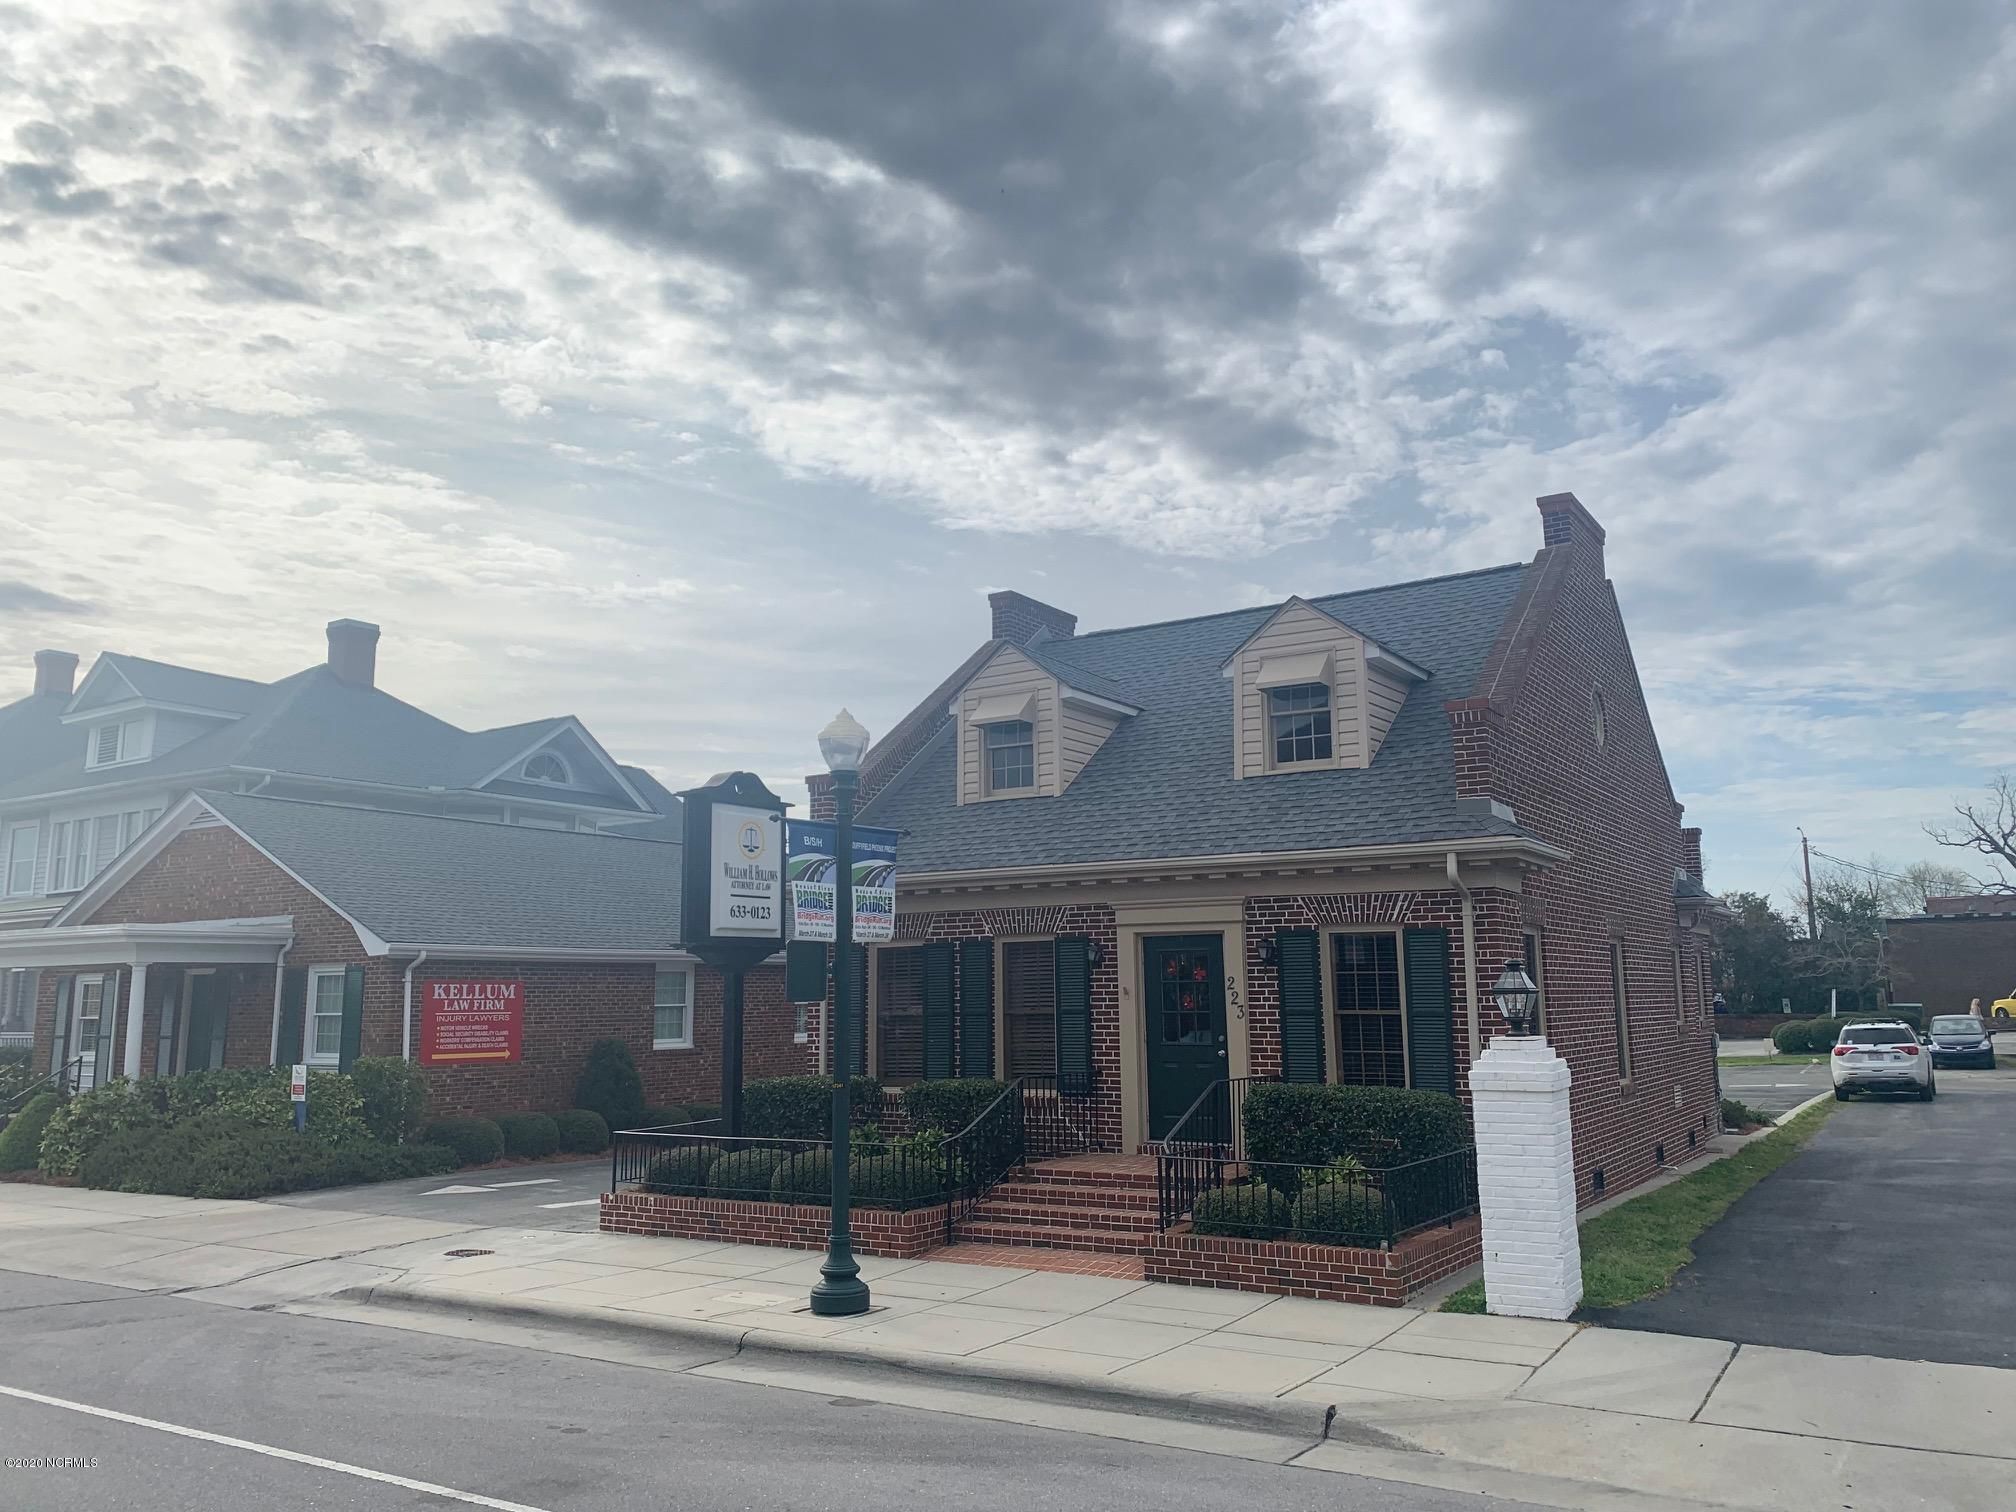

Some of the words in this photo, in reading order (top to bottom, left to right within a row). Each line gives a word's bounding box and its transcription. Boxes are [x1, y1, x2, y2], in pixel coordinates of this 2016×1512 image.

[804, 836, 823, 847] B/S/H
[723, 862, 748, 879] WILLIAM
[748, 864, 754, 881] H.
[755, 865, 779, 882] HOLLOWS
[730, 880, 754, 890] ATTORNEY
[755, 882, 762, 891] AT
[762, 882, 772, 891] LAW
[796, 890, 828, 910] BRIDGE
[856, 895, 888, 914] BRIDGE
[730, 904, 772, 920] 633-0123
[432, 983, 516, 998] KELLUM
[1226, 976, 1245, 1020] 223
[443, 999, 470, 1010] LAW
[473, 999, 505, 1010] FIRM
[469, 1014, 510, 1022] LAWYERS
